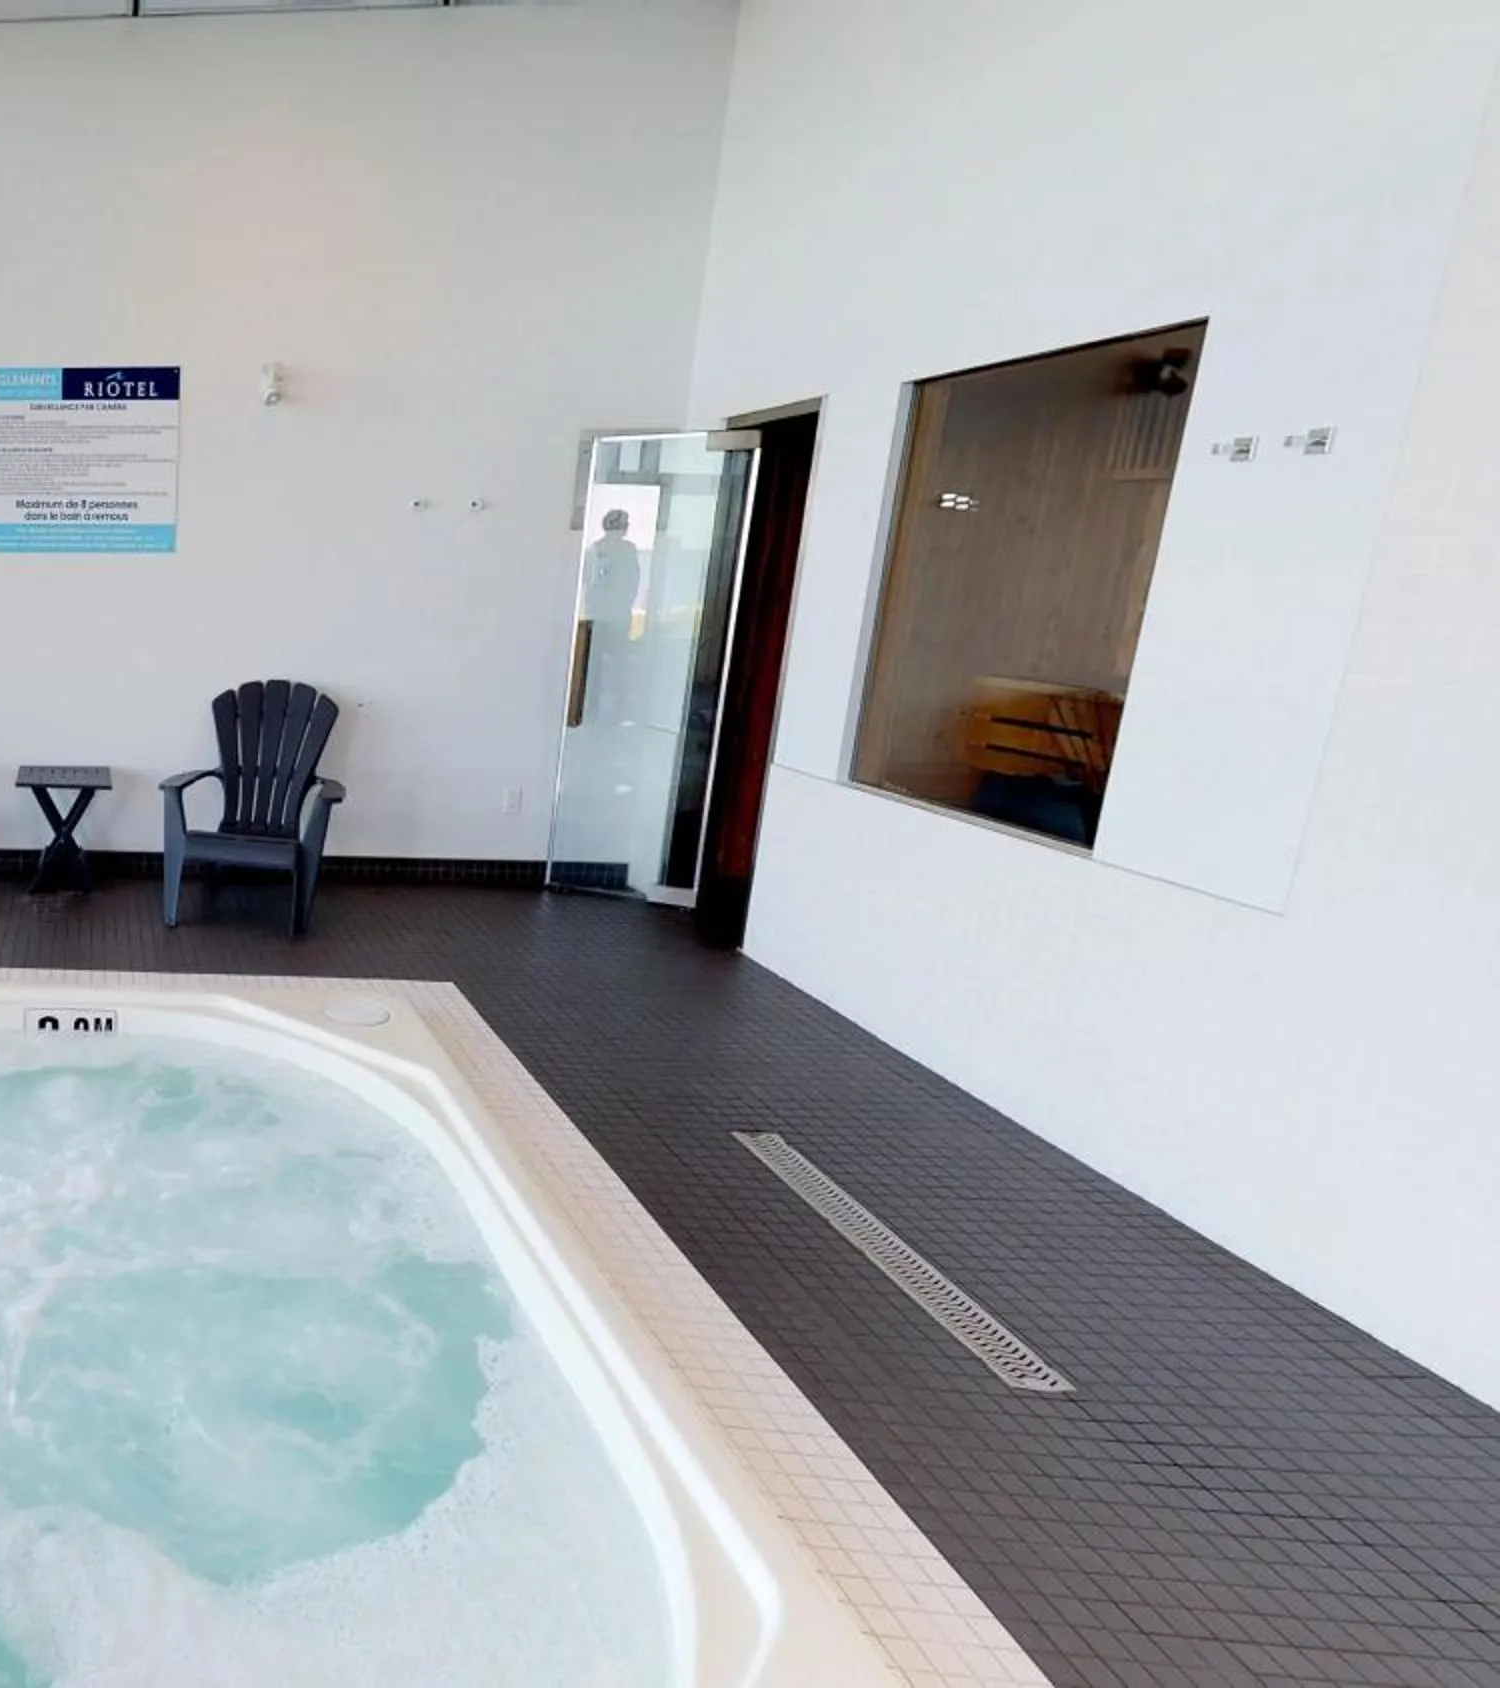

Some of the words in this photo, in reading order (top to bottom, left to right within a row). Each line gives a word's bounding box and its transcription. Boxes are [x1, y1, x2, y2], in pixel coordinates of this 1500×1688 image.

[83, 381, 158, 397] RIOTEL
[15, 499, 63, 509] Maximum
[65, 499, 78, 509] de
[88, 500, 138, 512] personnes
[23, 511, 48, 521] dans
[49, 511, 58, 521] le
[59, 511, 81, 521] bain
[91, 513, 129, 521] remous
